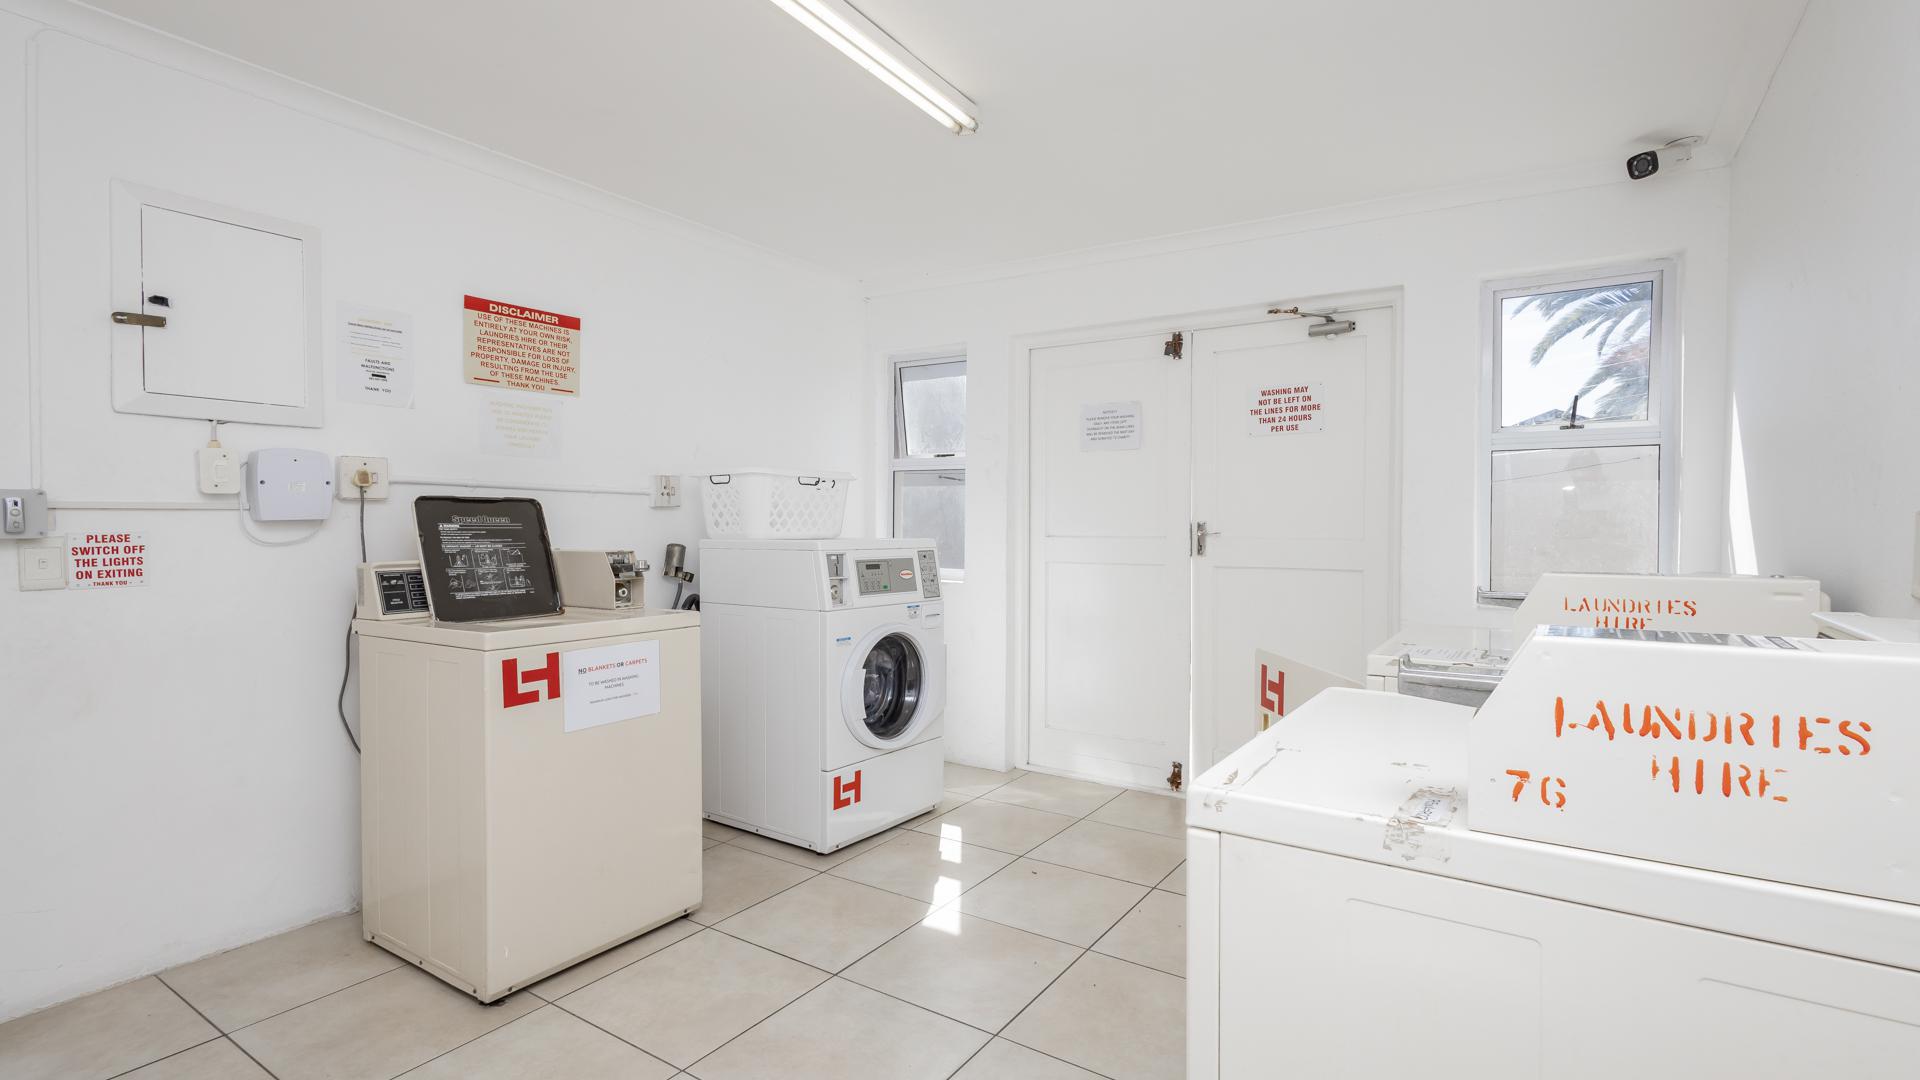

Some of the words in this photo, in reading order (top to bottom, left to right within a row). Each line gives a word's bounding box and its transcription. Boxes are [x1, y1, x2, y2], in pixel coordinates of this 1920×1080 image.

[489, 304, 559, 324] DISCLAIMER
[474, 320, 507, 331] ENTIRELY
[519, 328, 538, 336] YOUR
[540, 332, 555, 340] OWN
[478, 313, 492, 321] USE
[505, 318, 527, 327] THESE
[528, 322, 562, 334] MACHINES
[477, 336, 541, 353] REPRESENTATIVES
[480, 330, 519, 342] LAUNDRIES
[521, 336, 537, 345] HIRE
[550, 341, 567, 350] THEIR
[477, 344, 526, 358] RESPONSIBLE
[528, 352, 541, 360] FOR
[543, 355, 560, 363] LOSS
[480, 361, 519, 372] RESULTING
[520, 367, 540, 375] FROM
[511, 358, 540, 368] DAMAGE
[542, 362, 551, 370] OR
[501, 372, 523, 380] THESE
[1261, 388, 1292, 397] WASHING
[1258, 398, 1271, 406] NOT
[1284, 396, 1300, 404] LEFT
[1250, 408, 1262, 416] THE
[1264, 407, 1283, 415] LINES
[1300, 403, 1321, 412] MORE
[1288, 414, 1312, 422] HOURS
[1286, 424, 1299, 432] USE
[86, 534, 131, 544] PLEASE
[71, 546, 119, 556] SWITCH
[123, 545, 145, 554] OFF
[74, 558, 98, 568] THE
[102, 556, 144, 567] LIGHTS
[75, 570, 93, 580] ON
[97, 568, 143, 579] EXITING
[1564, 596, 1697, 617] LAUNDRIES
[578, 667, 587, 675] NO
[588, 663, 616, 672] BLANKETS
[625, 658, 648, 666] CARPETS
[1554, 696, 1872, 756] LAUNDRIES
[1652, 755, 1789, 802] HIRE
[1505, 768, 1567, 809] 76
